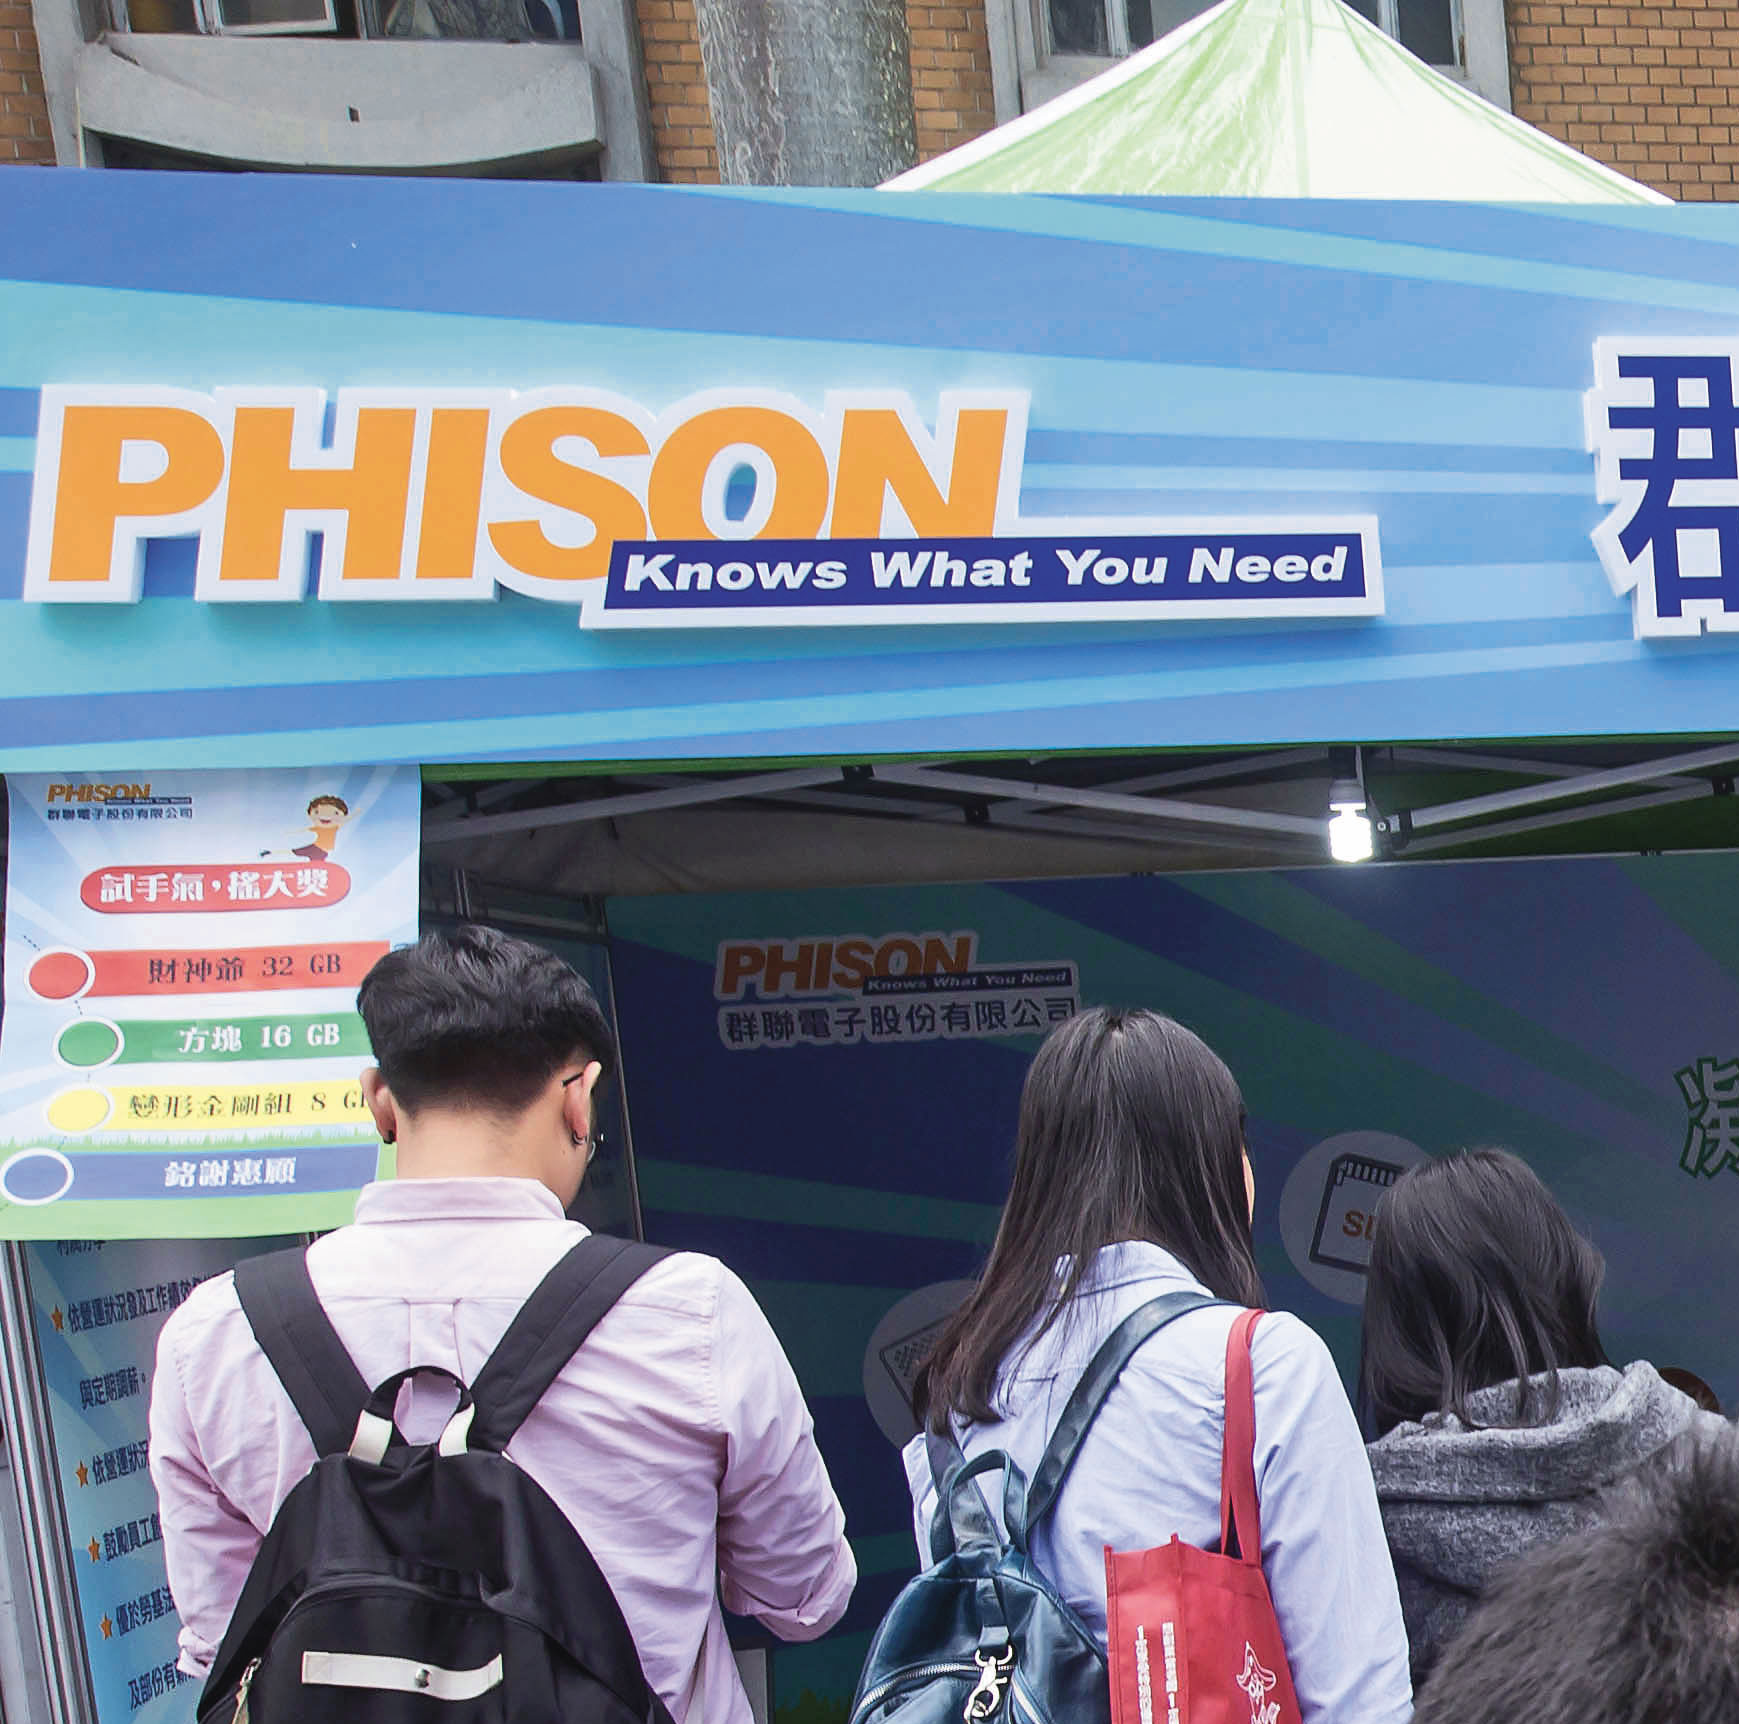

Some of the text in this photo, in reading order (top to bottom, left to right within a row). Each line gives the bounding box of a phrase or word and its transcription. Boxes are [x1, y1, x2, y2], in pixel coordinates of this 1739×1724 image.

[49, 404, 1008, 581] PHISON
[623, 546, 1348, 591] Knows What You Need
[47, 783, 151, 803] PHISON
[262, 956, 294, 978] 32
[310, 953, 341, 975] GB
[721, 936, 974, 994] PHISON
[260, 1024, 291, 1049] 16
[306, 1023, 341, 1047] GB
[725, 996, 1077, 1044] 群聯電子股份有限公司
[310, 1092, 326, 1112] 8
